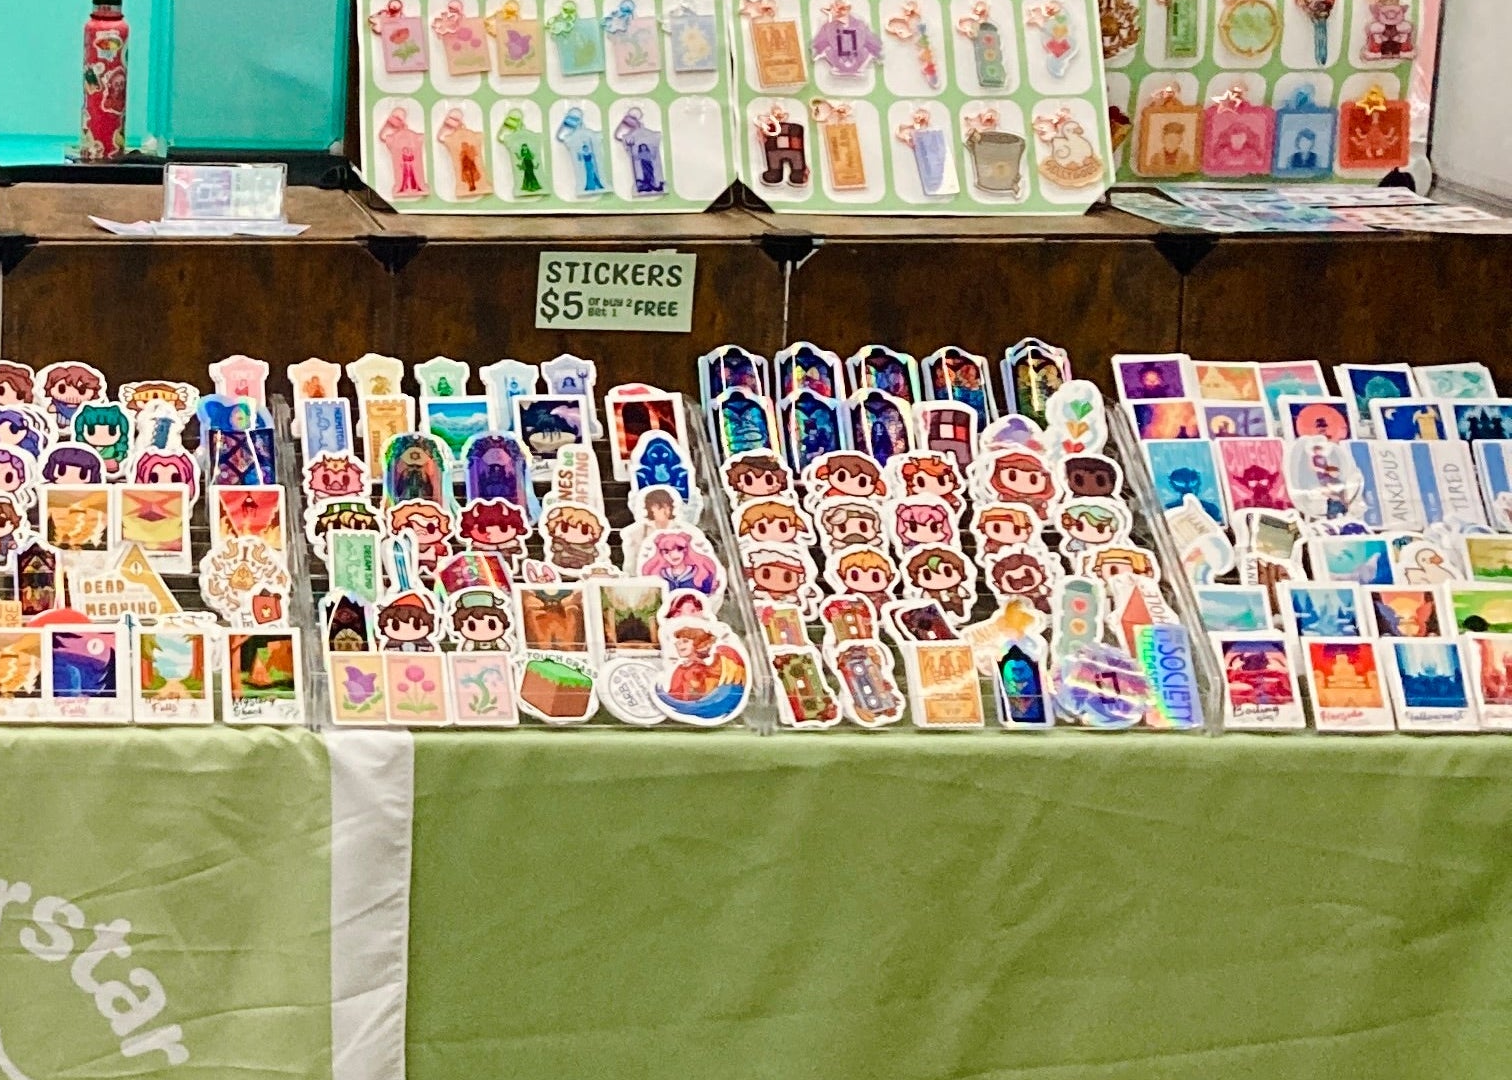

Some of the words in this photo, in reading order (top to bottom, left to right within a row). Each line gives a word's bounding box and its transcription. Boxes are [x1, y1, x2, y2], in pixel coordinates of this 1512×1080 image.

[546, 260, 683, 288] STICKERS
[540, 286, 584, 323] $5
[634, 300, 679, 317] FREE
[1379, 449, 1408, 521] ANXIOUS
[1443, 463, 1469, 512] TIRED
[84, 579, 125, 595] DEAD
[527, 652, 563, 662] TOUCH
